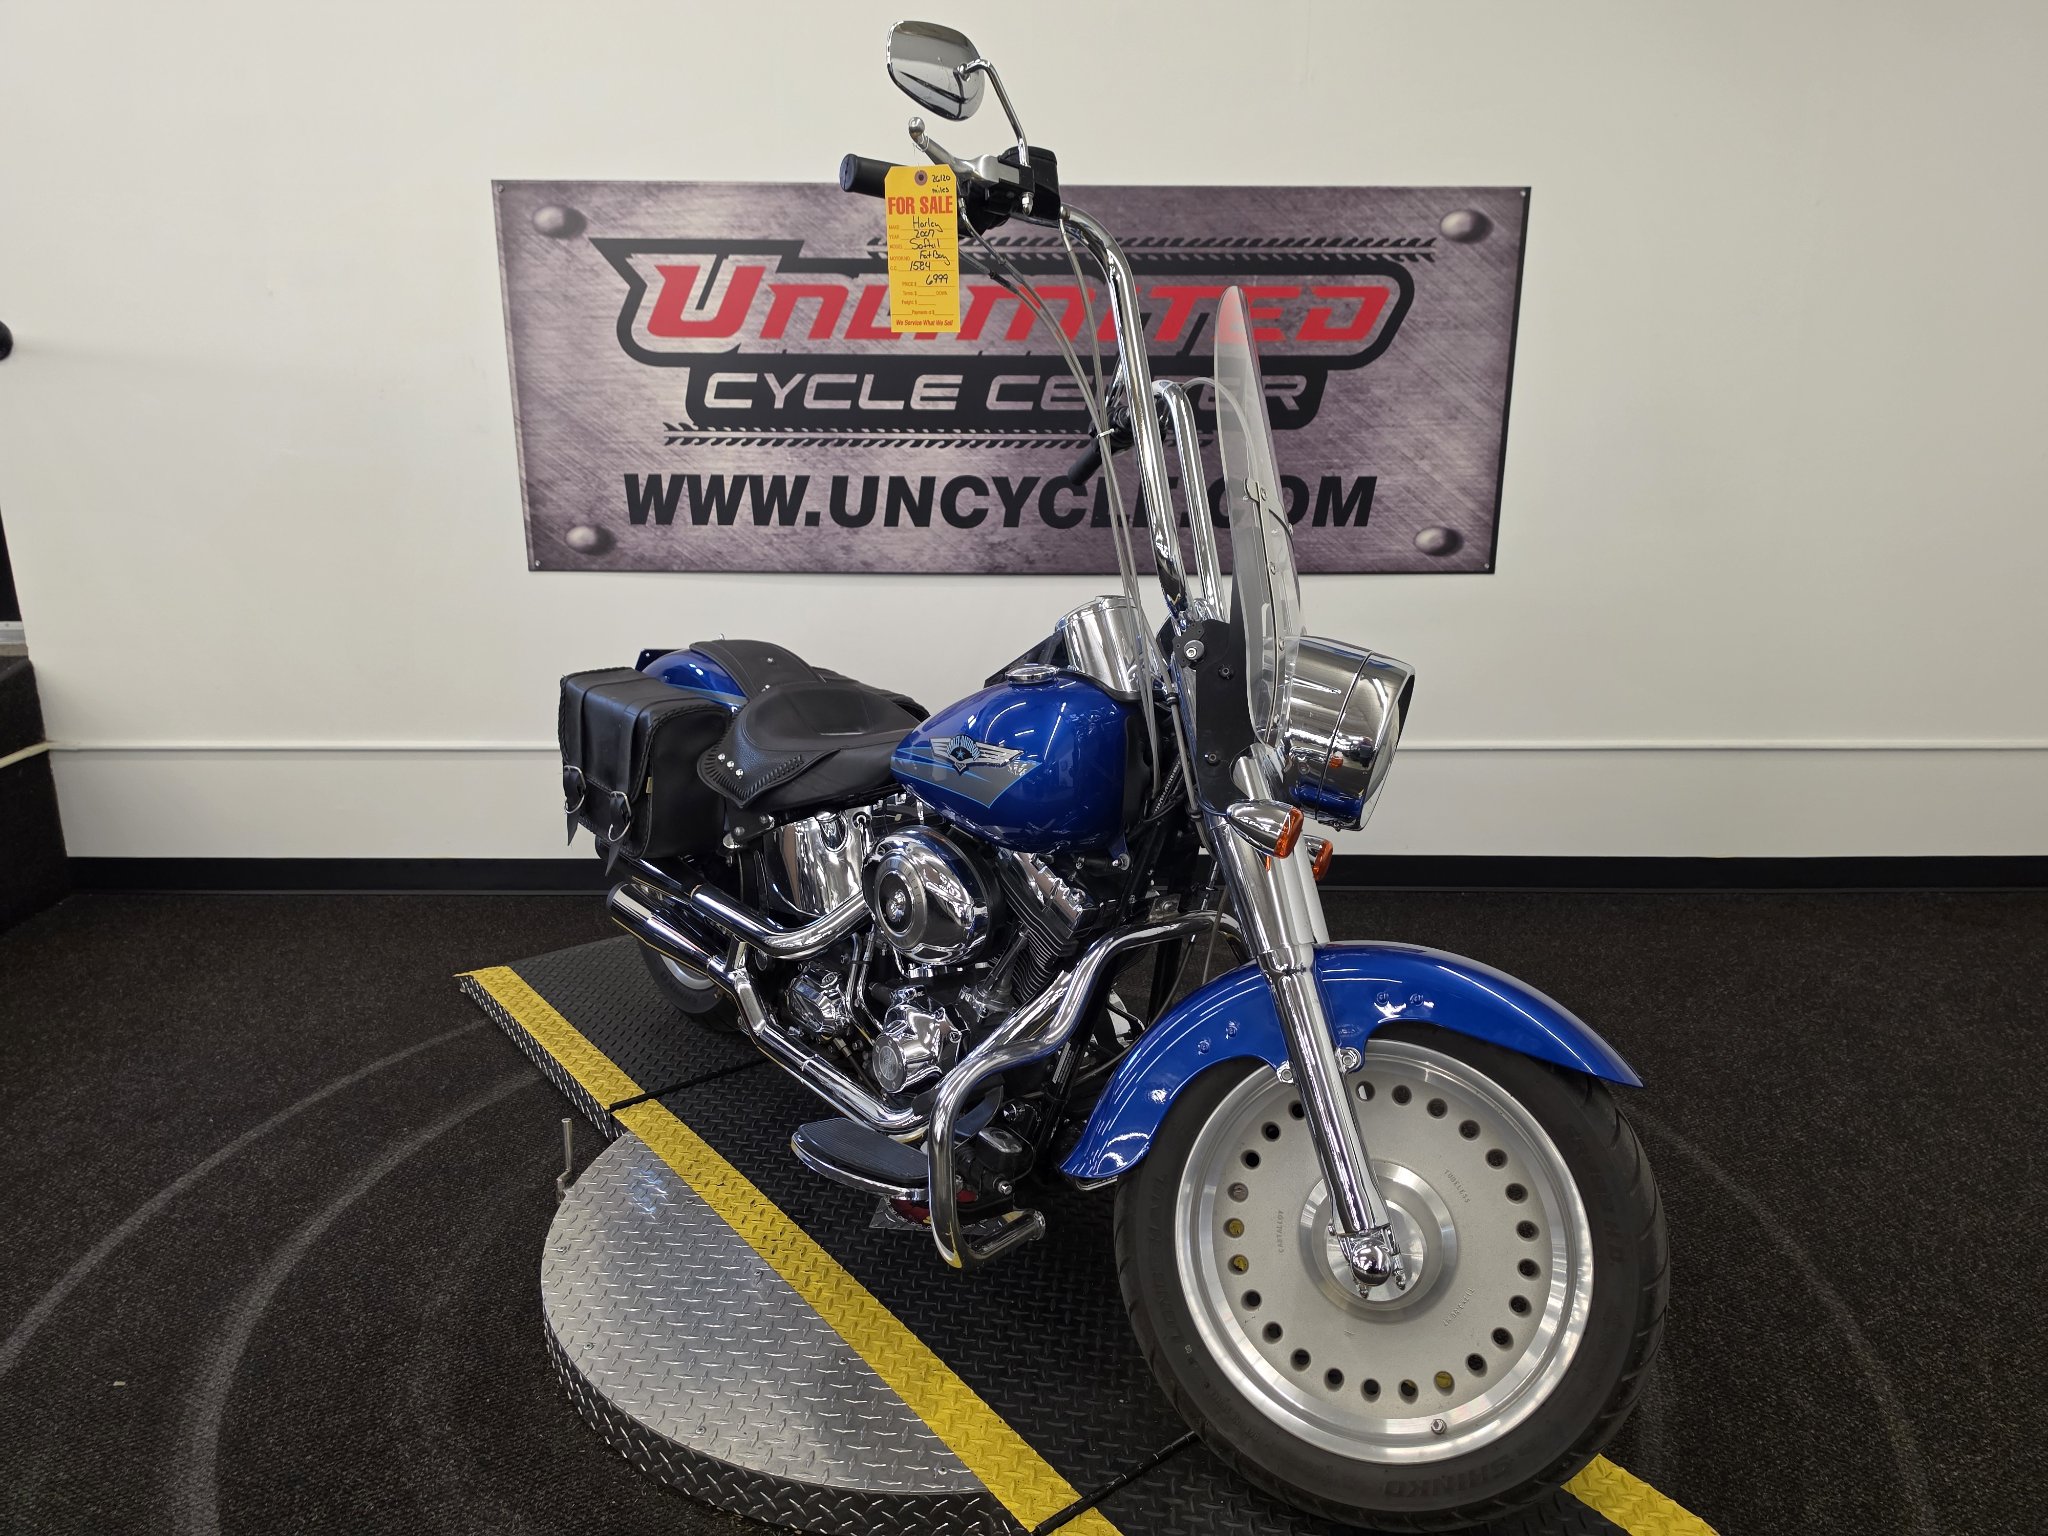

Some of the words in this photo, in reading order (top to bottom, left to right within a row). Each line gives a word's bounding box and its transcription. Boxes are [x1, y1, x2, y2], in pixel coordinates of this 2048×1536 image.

[931, 174, 951, 183] 26120
[887, 196, 915, 216] FOR
[920, 195, 953, 214] SALE
[912, 215, 944, 233] Harley
[909, 260, 931, 272] 1584
[925, 273, 949, 286] 6999
[647, 265, 1391, 341] UNLMTED
[703, 371, 964, 411] CYCLE
[985, 374, 1307, 411] CEER
